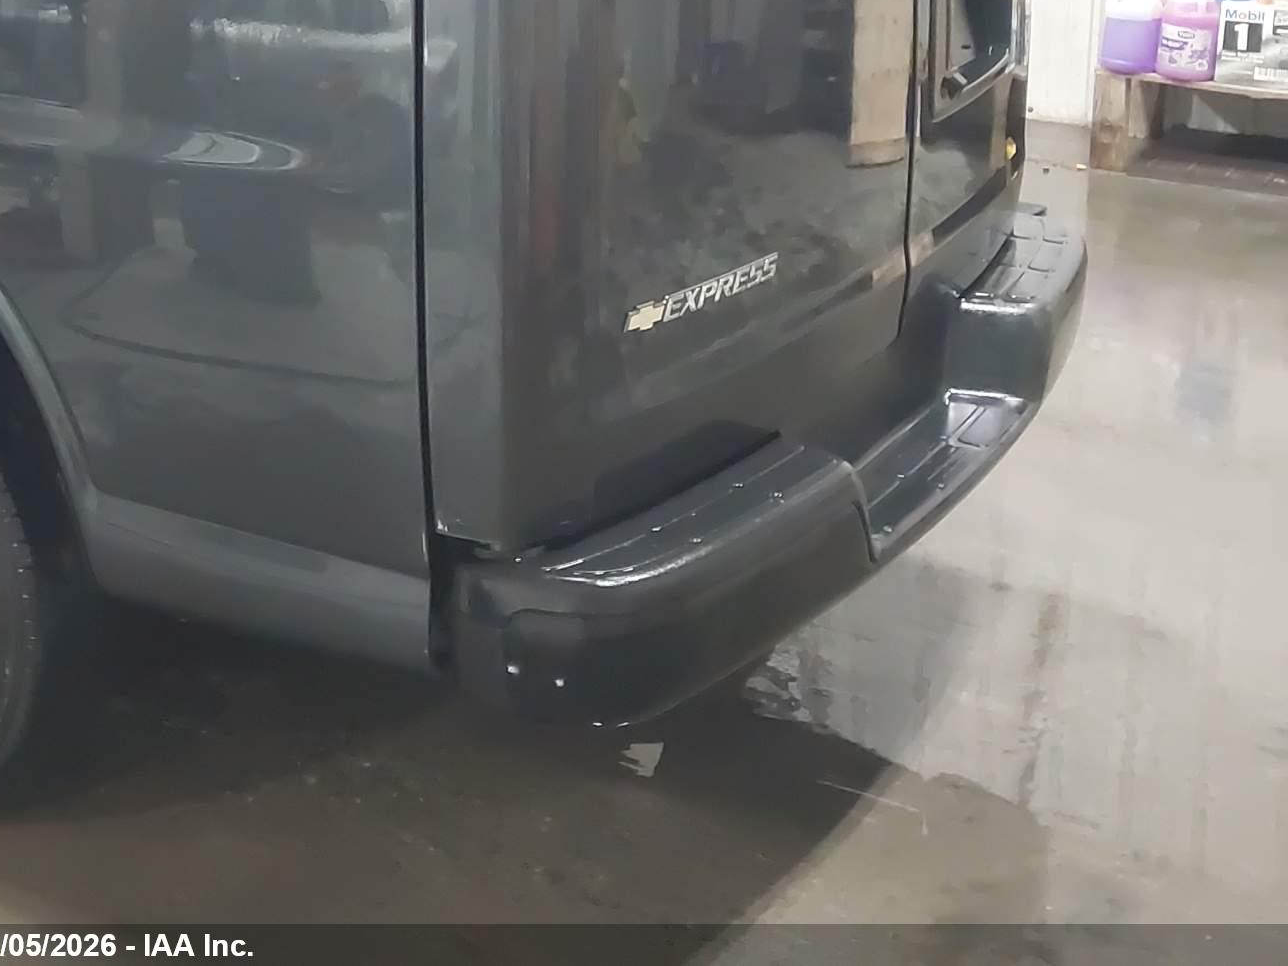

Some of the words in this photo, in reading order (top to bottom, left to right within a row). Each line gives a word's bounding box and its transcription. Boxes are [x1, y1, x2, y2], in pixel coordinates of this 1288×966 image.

[1225, 8, 1265, 21] Mobil
[1234, 23, 1249, 51] 1
[663, 251, 779, 323] EXPRESS
